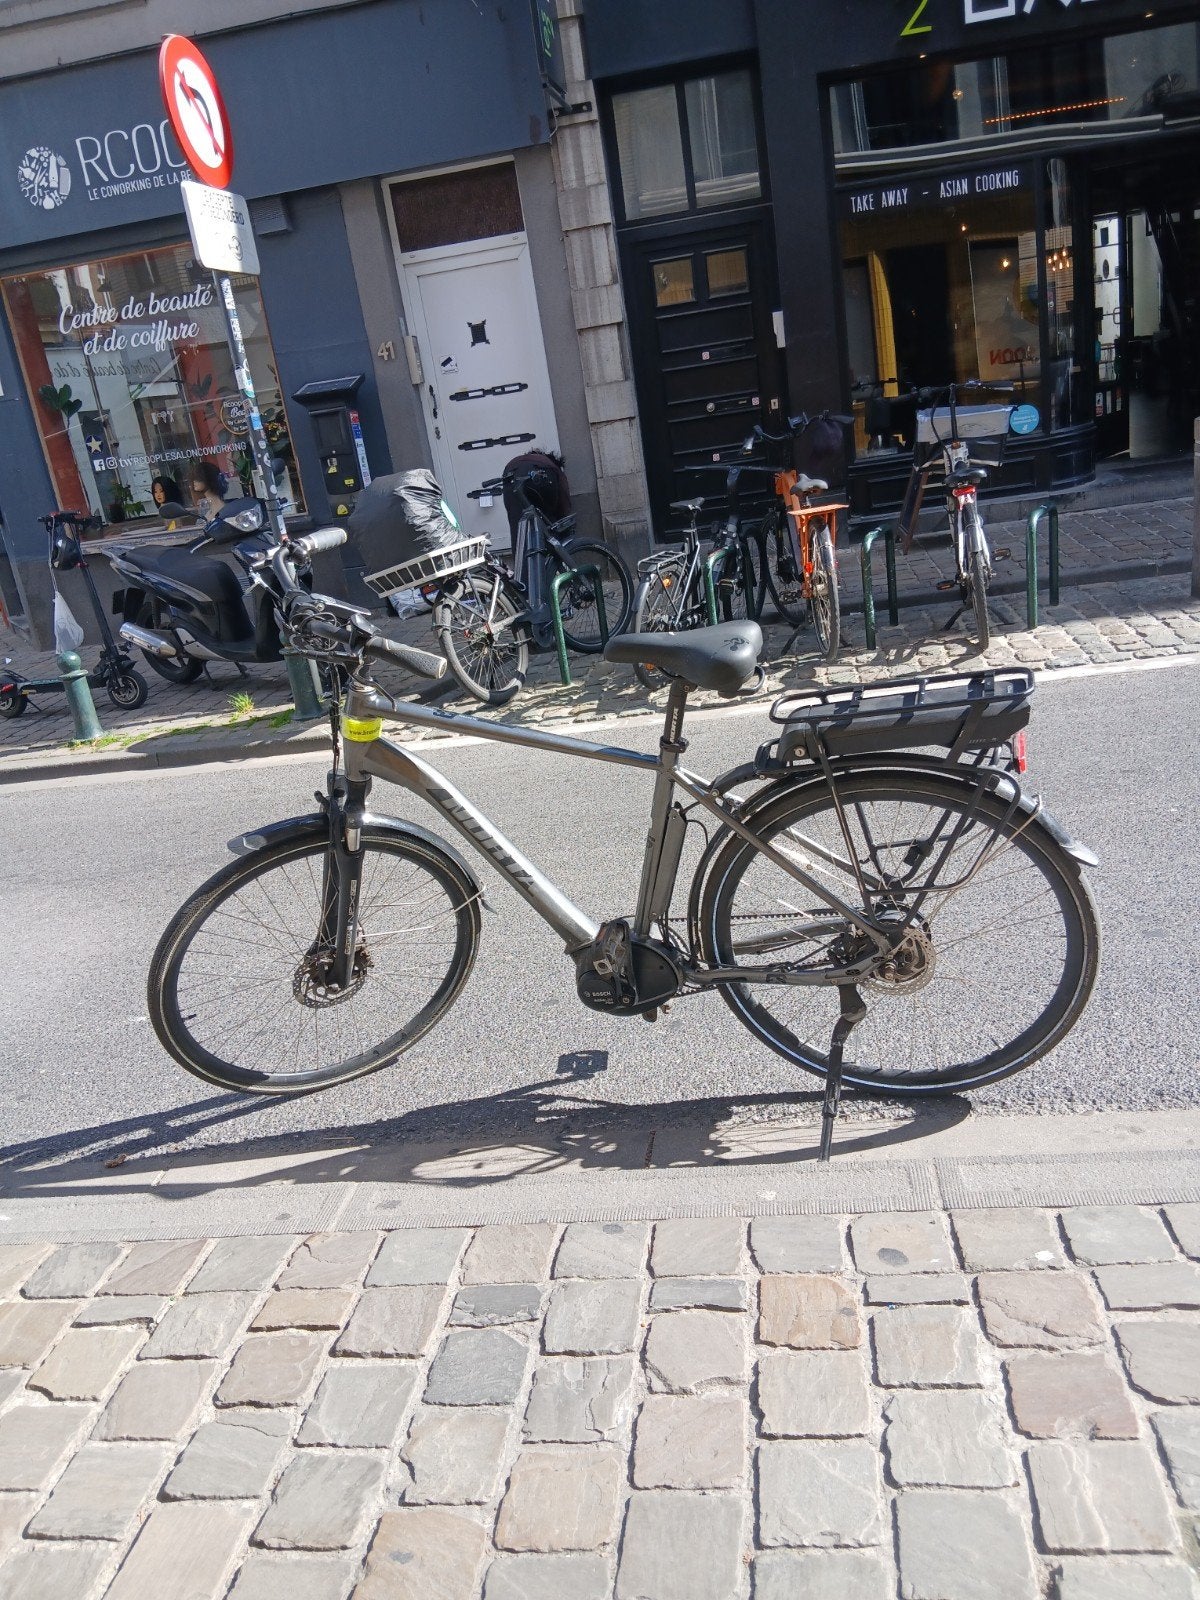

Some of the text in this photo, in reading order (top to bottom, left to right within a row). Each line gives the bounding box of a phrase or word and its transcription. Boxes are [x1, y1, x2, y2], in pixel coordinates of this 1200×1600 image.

[88, 187, 99, 201] LE
[100, 178, 152, 199] COWORKING
[153, 174, 166, 188] DE
[166, 170, 179, 184] LA
[850, 193, 875, 213] TAKE
[881, 188, 909, 209] AWAY
[940, 178, 969, 199] ASIAN
[975, 169, 1020, 193] COOKING
[59, 304, 119, 335] Centre
[121, 295, 146, 321] de
[148, 284, 214, 316] beauté
[83, 319, 201, 356] et de coiffure
[377, 341, 395, 361] 41
[592, 990, 612, 998] BOSCH
